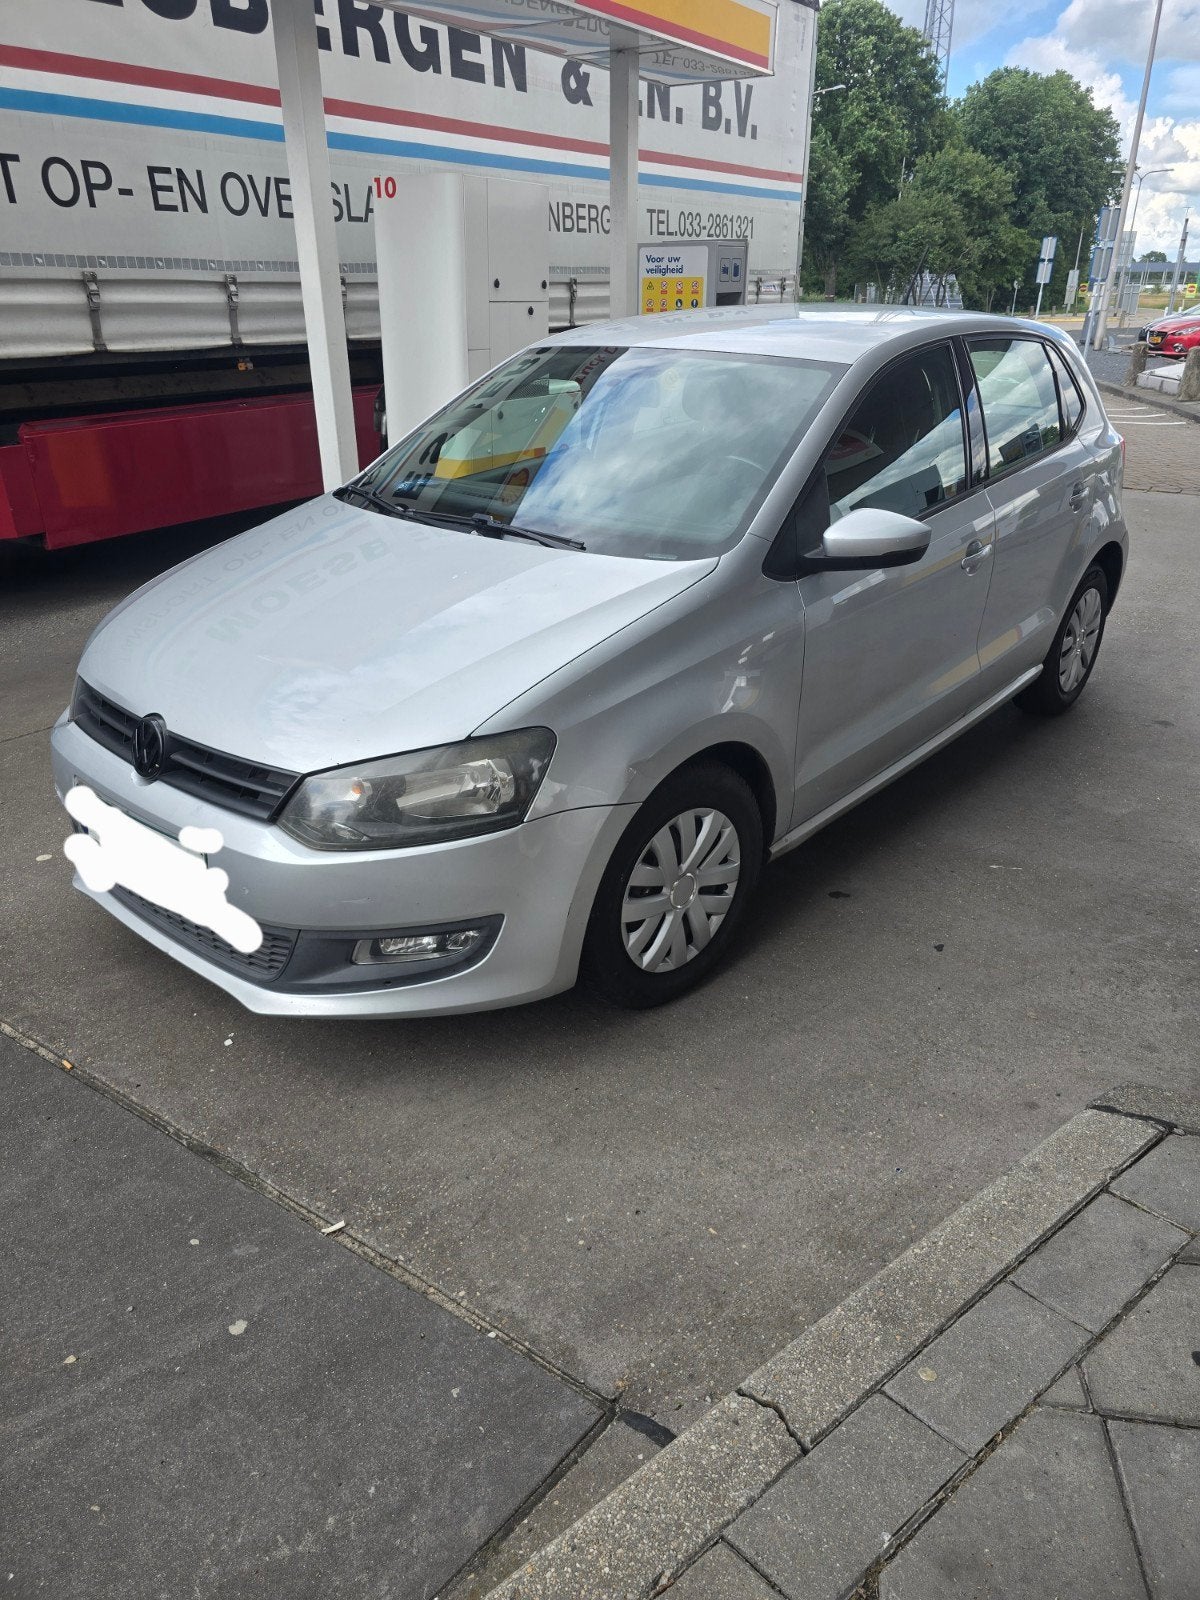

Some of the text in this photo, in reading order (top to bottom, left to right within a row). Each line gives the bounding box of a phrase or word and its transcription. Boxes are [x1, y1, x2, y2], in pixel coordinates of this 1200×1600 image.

[560, 59, 594, 107] &
[701, 80, 758, 140] B.V.
[41, 156, 134, 208] OP-
[146, 165, 209, 214] EN
[373, 176, 397, 199] 10
[646, 208, 755, 239] TEL.033-2861321
[645, 254, 665, 264] Voor
[645, 264, 684, 277] veiligheid
